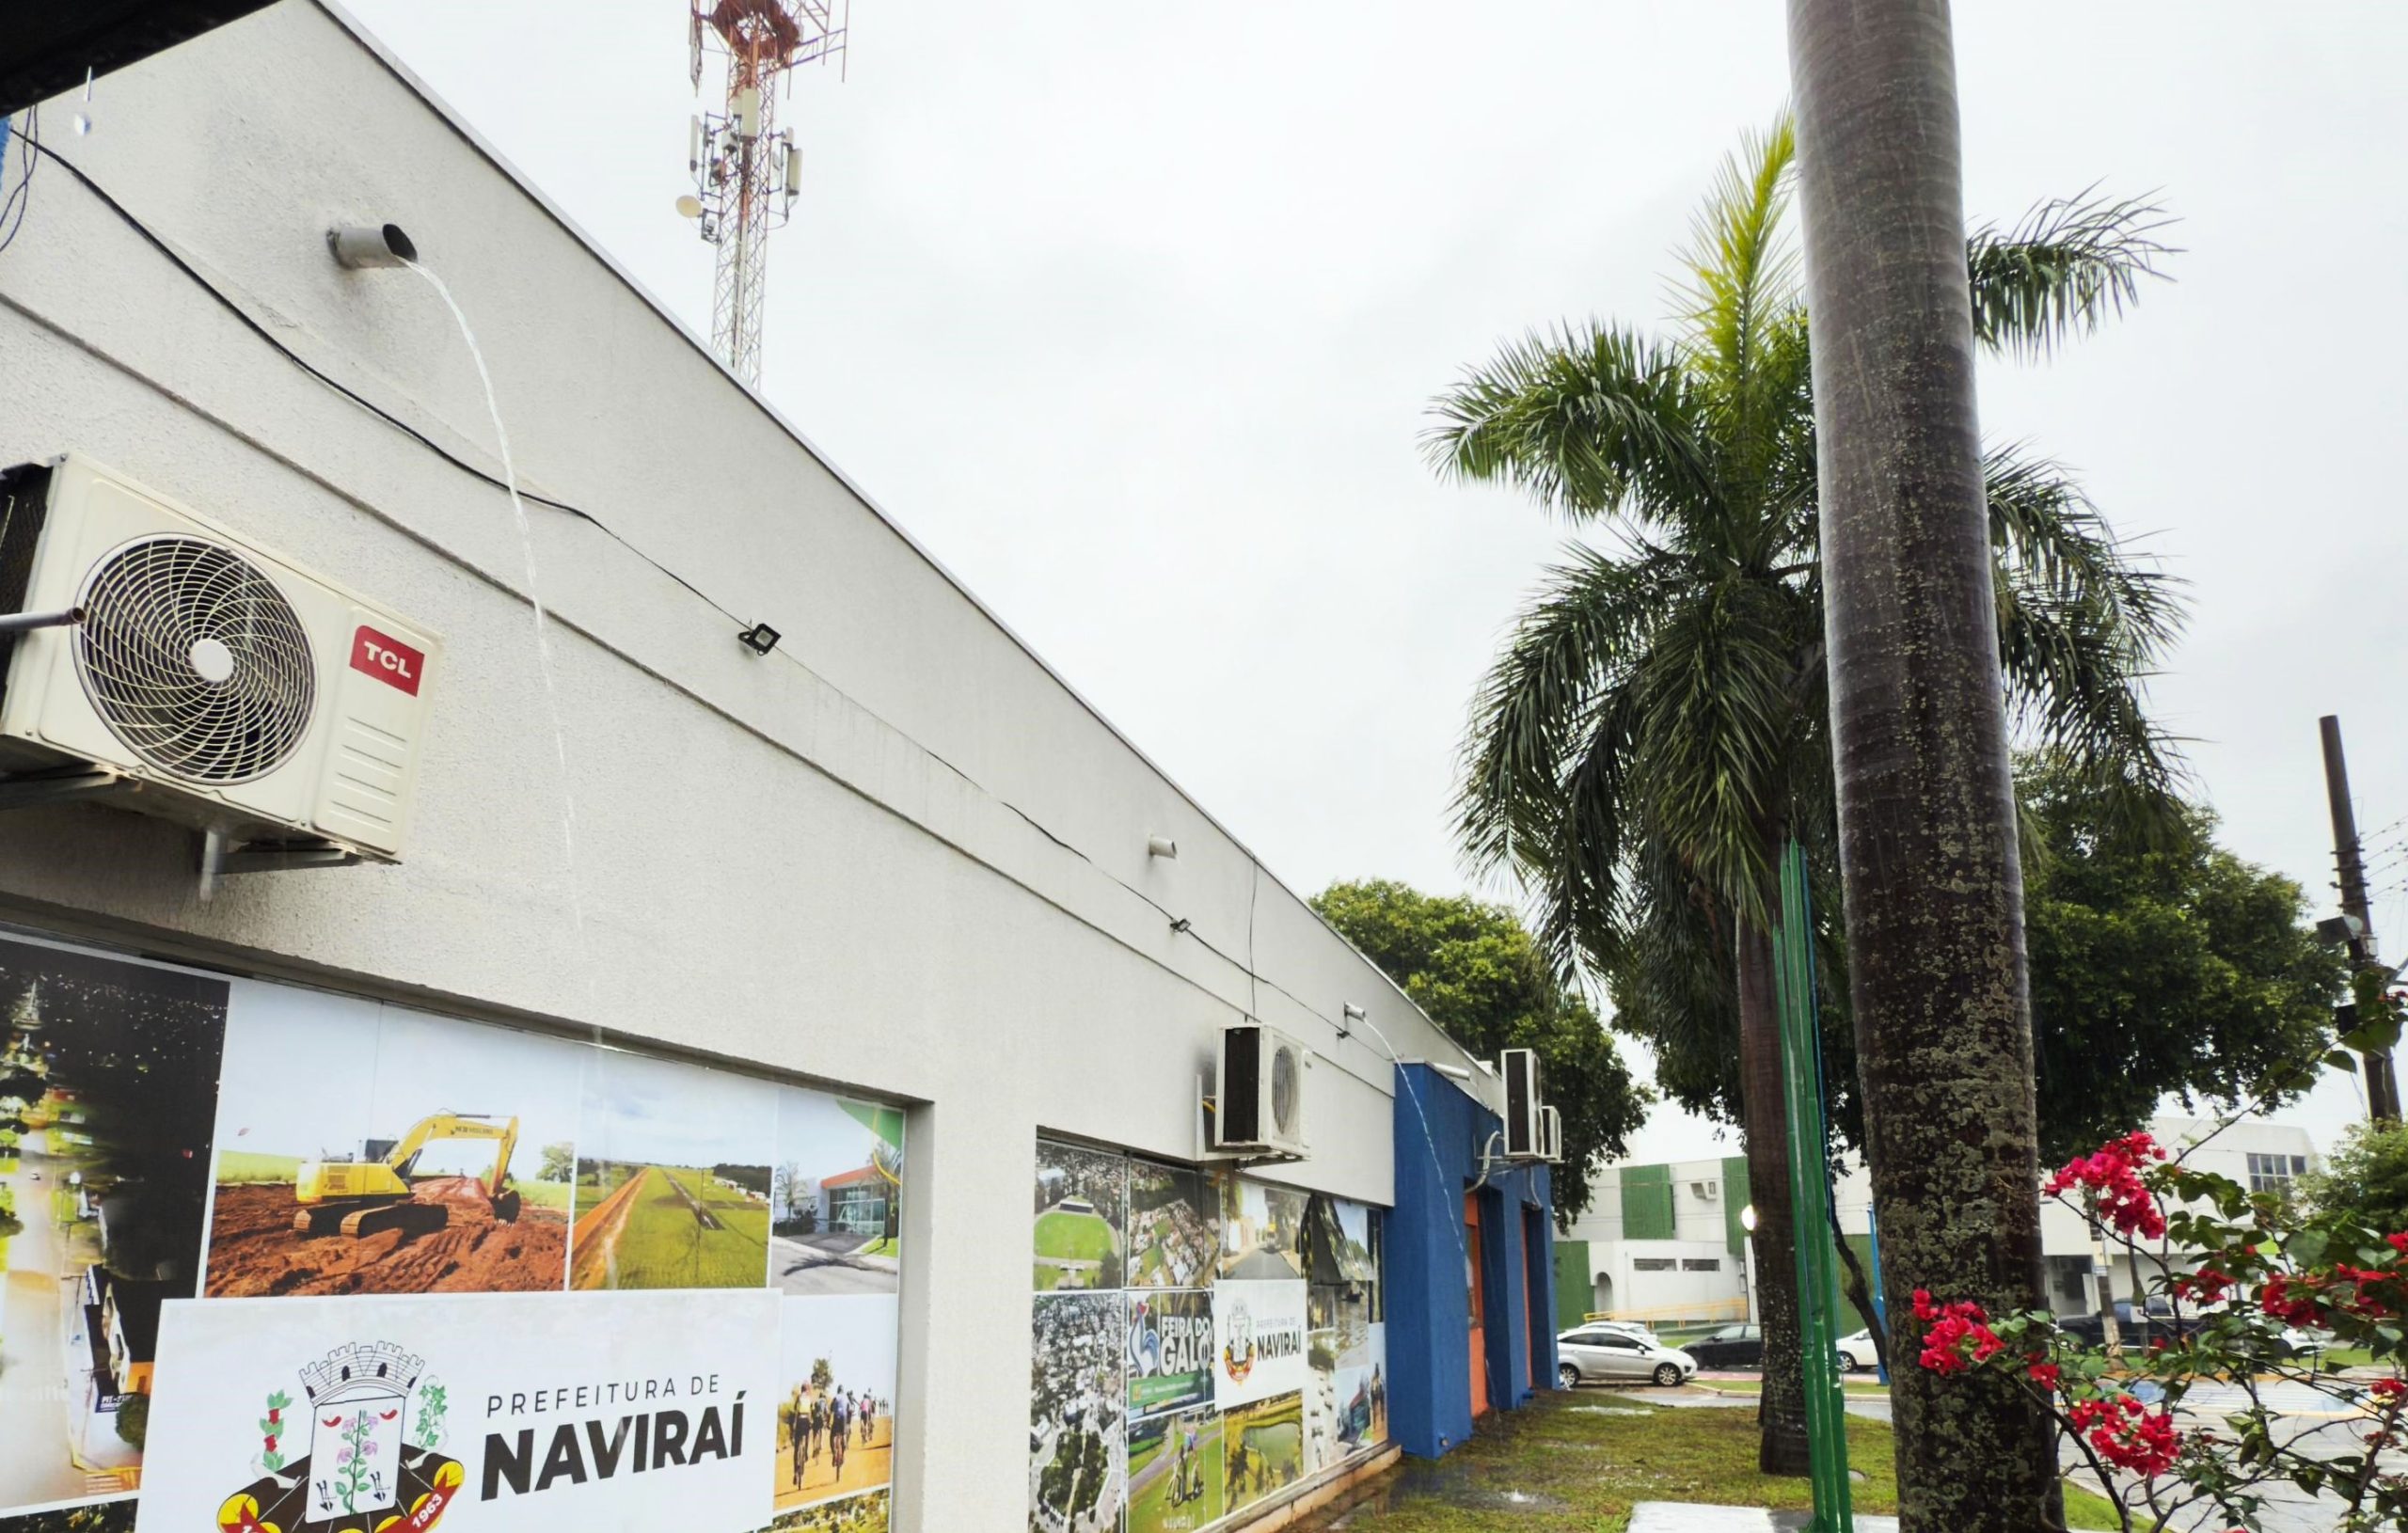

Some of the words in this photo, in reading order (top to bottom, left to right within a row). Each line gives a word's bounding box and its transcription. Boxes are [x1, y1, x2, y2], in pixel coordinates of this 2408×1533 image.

[364, 640, 411, 678] TCL
[1161, 1317, 1194, 1338] FEIRA
[1195, 1317, 1211, 1336] DO
[1257, 1325, 1301, 1362] NAVIRAÍ
[1160, 1334, 1212, 1377] GALO
[487, 1378, 675, 1418] PREFEITURA
[690, 1374, 719, 1395] DE
[481, 1390, 747, 1502] NAVIRAÍ
[412, 1493, 443, 1529] 1963
